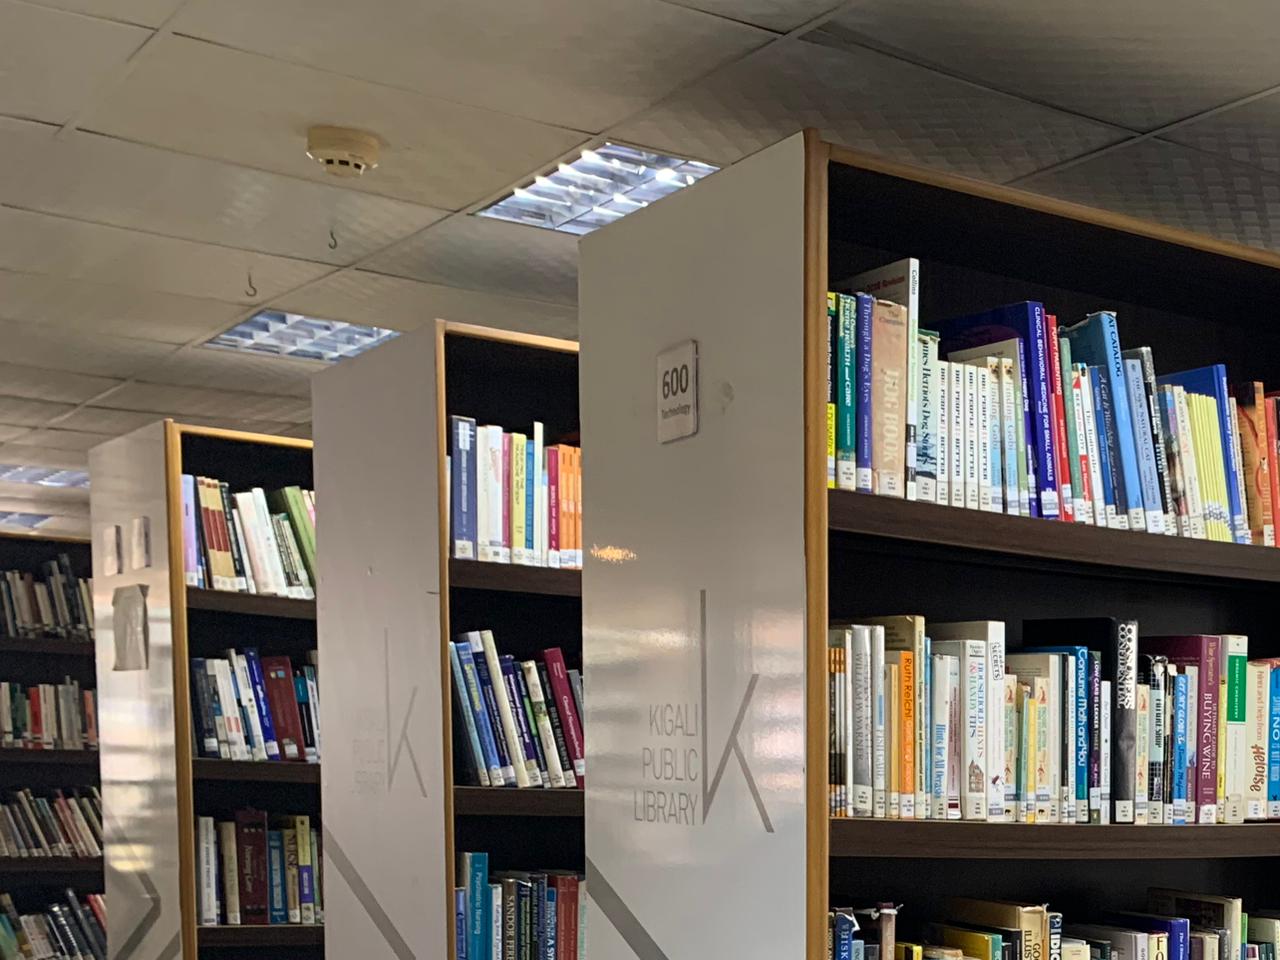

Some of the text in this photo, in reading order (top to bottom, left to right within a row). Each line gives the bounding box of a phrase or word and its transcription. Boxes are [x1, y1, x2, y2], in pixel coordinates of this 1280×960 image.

[1033, 306, 1042, 338] CLINICAL
[1035, 339, 1046, 381] BEHAVIORAL
[1110, 332, 1123, 377] CATALOG
[663, 364, 689, 400] 600
[1039, 382, 1049, 414] MEDICINE
[882, 412, 899, 462] BOOK
[1043, 430, 1051, 451] SMALL
[1045, 453, 1053, 482] ANIMALS
[1077, 647, 1088, 697] Consumer
[1117, 623, 1126, 709] CONFIDENTIAL
[1125, 623, 1135, 710] CONSUMERS
[854, 652, 864, 760] WILLIAM WARNER
[903, 657, 913, 718] Ruth Reichl
[968, 675, 977, 738] HANDY TIPS
[649, 702, 698, 738] KIGALI
[976, 661, 985, 758] HOUSEHOLD HINTS
[1077, 698, 1087, 725] Math
[935, 723, 945, 745] Hints
[1078, 726, 1087, 748] and
[1202, 692, 1213, 779] BUYING WINE
[642, 748, 698, 782] PUBLIC
[1249, 744, 1267, 792] Heloise
[634, 790, 699, 827] LIBRARY
